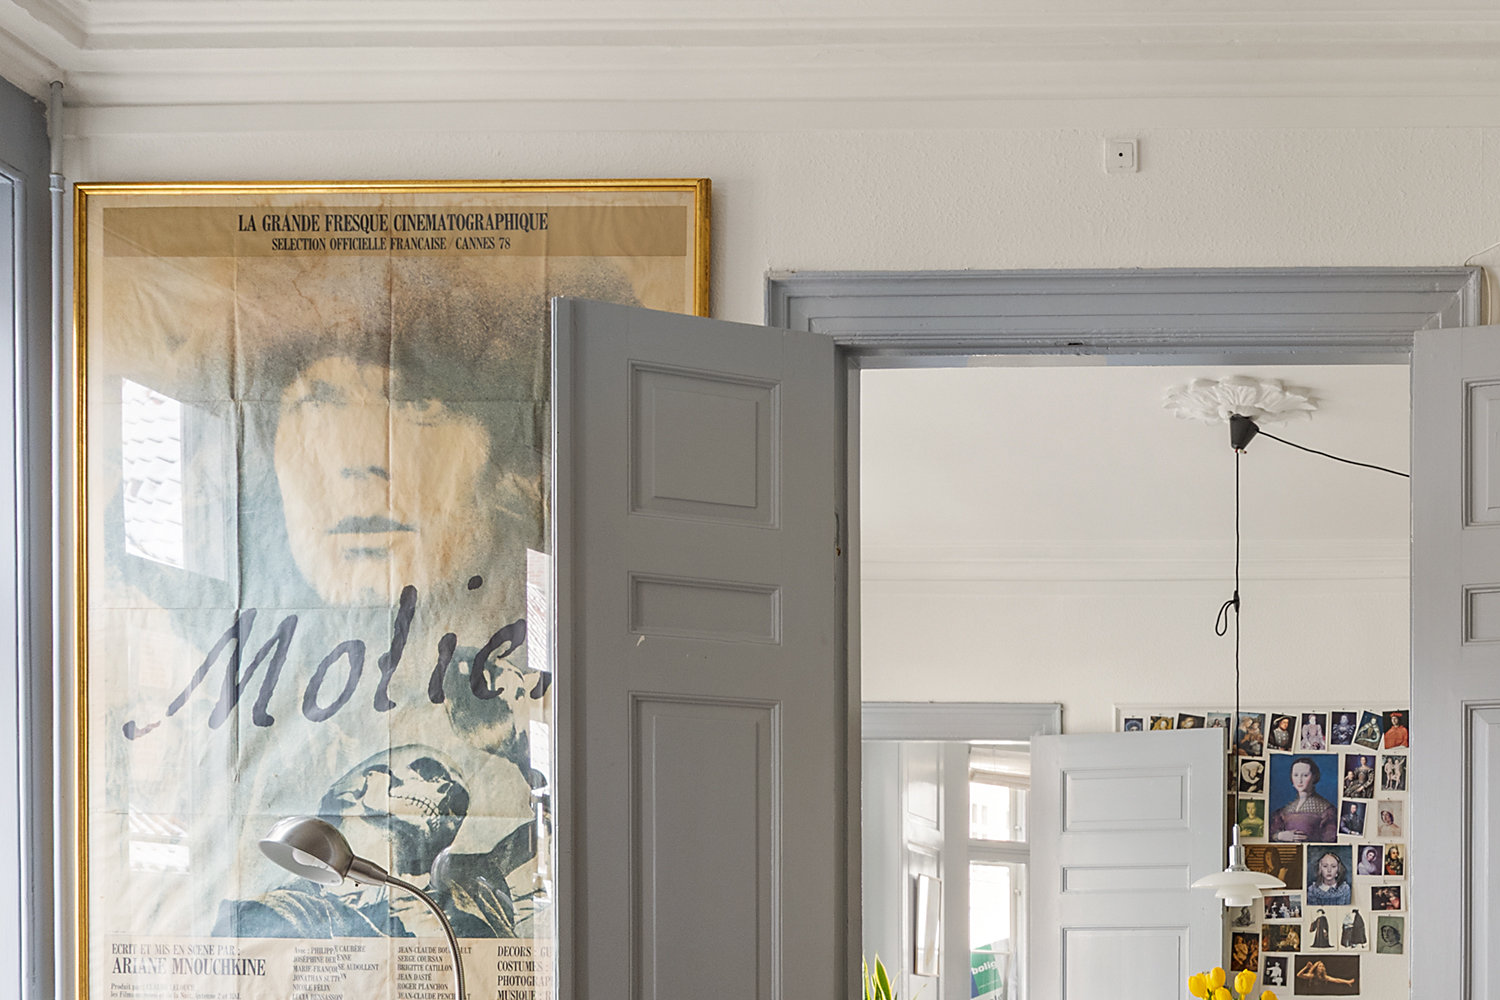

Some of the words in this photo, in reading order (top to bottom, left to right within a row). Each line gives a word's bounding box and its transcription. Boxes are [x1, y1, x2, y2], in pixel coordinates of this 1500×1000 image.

[238, 214, 257, 232] LA
[262, 214, 320, 232] GRANDE
[325, 214, 388, 234] FRESQUE
[394, 212, 548, 233] CINEMATOGRAPHIQUE
[272, 238, 326, 251] SELECTION
[330, 237, 387, 250] OFFICIELLE
[390, 237, 446, 250] FRANCAISE
[456, 237, 495, 250] CANNES
[499, 237, 511, 250] 78
[112, 943, 136, 955] ECRIT
[497, 946, 532, 957] DECORS
[112, 957, 167, 974] ARIANE
[172, 958, 266, 976] MNOUCHKINE
